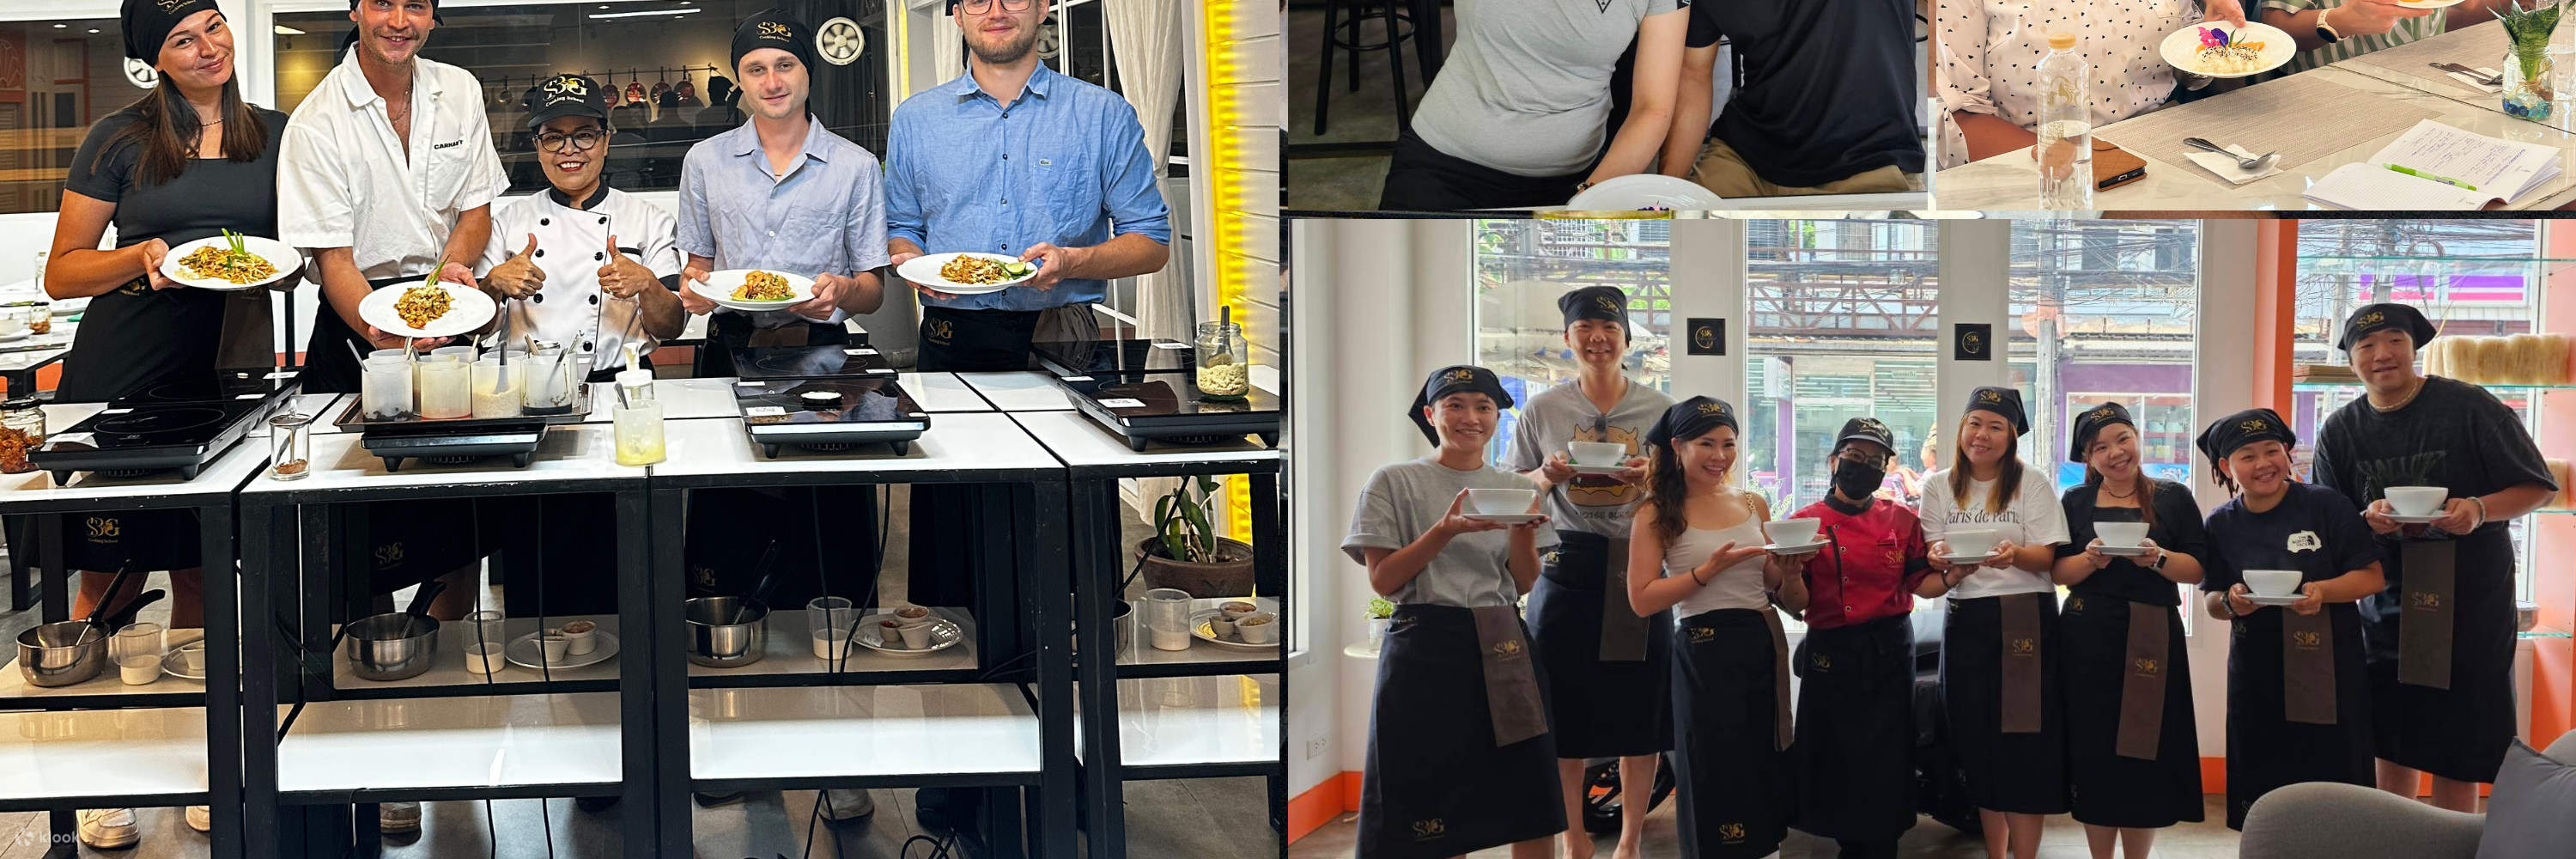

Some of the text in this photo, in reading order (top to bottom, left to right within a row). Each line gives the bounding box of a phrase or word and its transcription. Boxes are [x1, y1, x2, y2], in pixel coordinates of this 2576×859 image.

[545, 95, 585, 107] Cooking School
[1975, 509, 1990, 523] de
